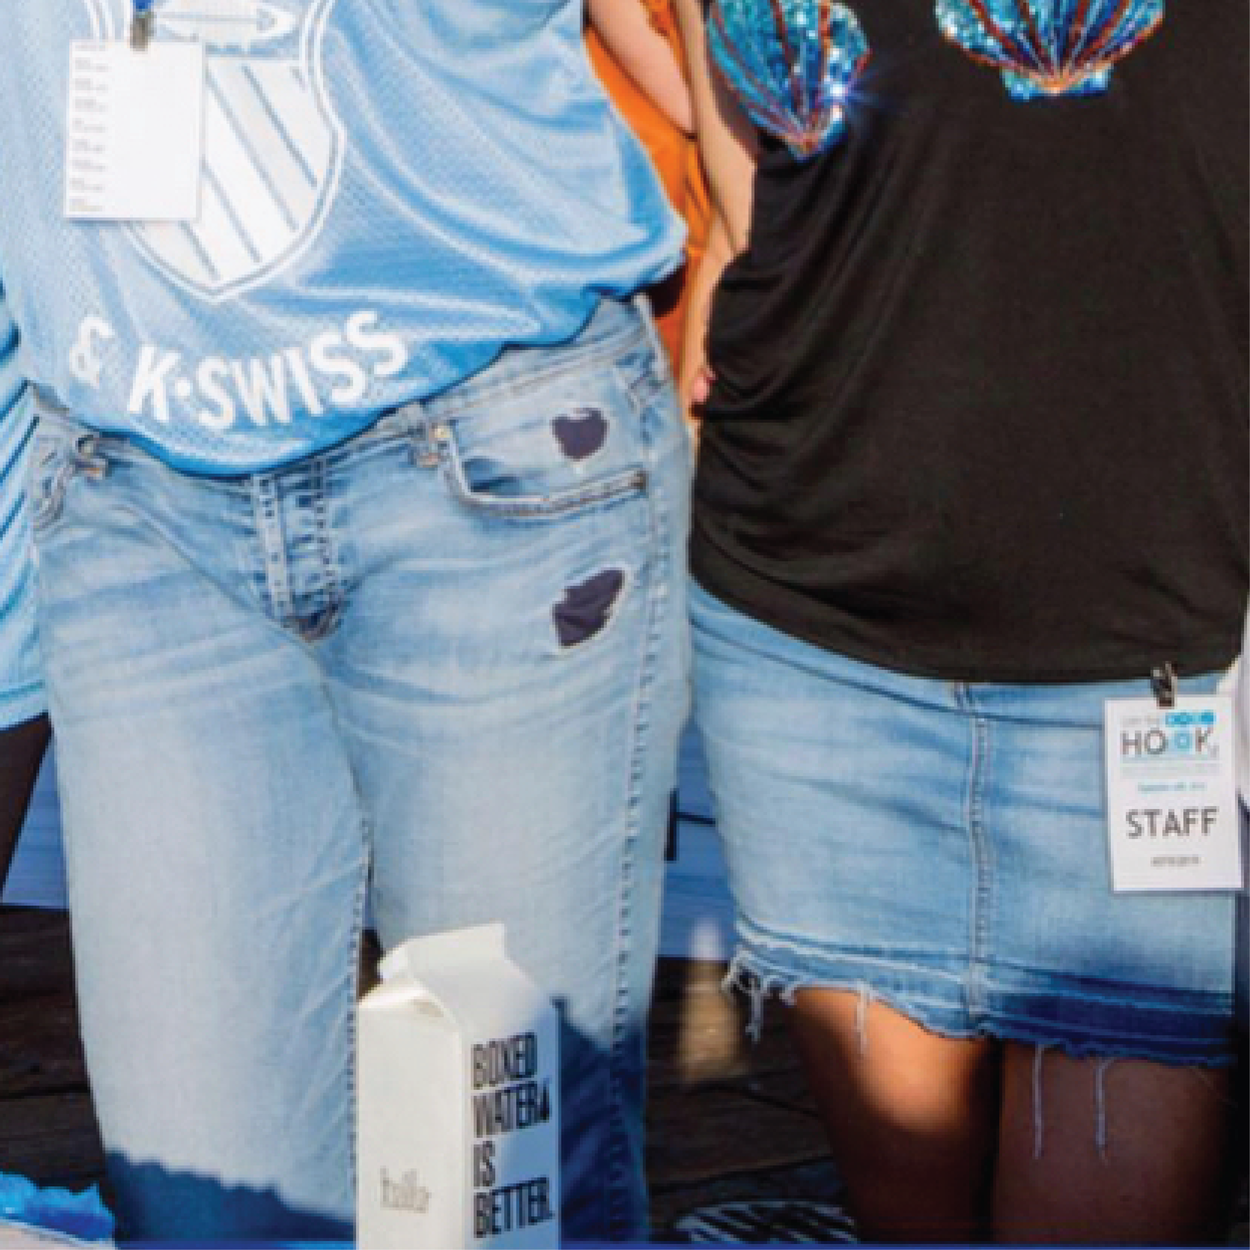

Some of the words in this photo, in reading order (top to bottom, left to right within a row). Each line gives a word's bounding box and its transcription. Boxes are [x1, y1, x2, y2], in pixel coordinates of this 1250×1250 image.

[69, 313, 116, 390] &
[1125, 805, 1219, 840] STAFF
[470, 1030, 538, 1090] BOXED
[472, 1140, 496, 1189] IS
